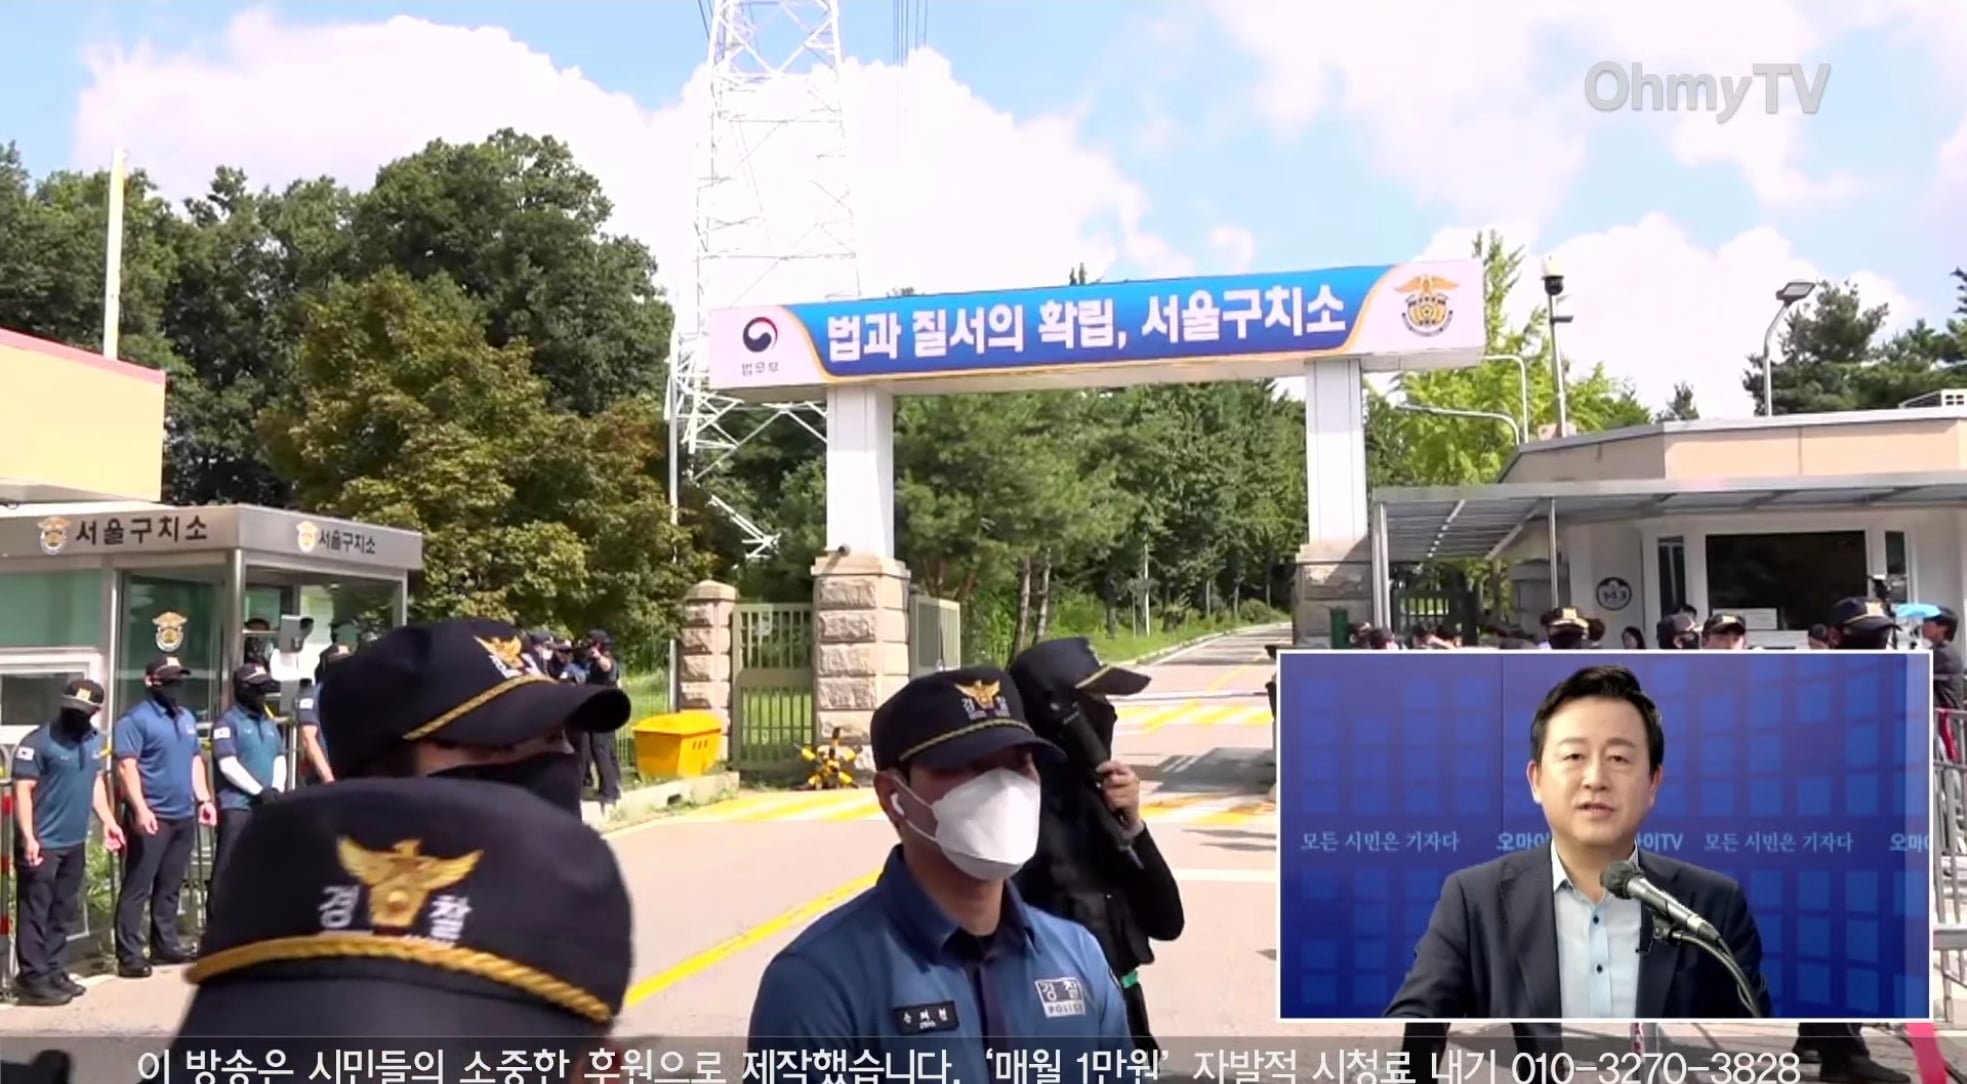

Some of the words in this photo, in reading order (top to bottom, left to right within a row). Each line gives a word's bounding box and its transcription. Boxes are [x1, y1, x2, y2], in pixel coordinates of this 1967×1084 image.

[826, 312, 901, 363] 법과
[912, 304, 1024, 358] 질서의
[1038, 299, 1127, 351] 확립,
[1141, 284, 1347, 344] 서울구치소
[75, 515, 208, 546] 서울구치소
[318, 530, 376, 555] 서울구치소
[1302, 832, 1338, 852] 모든
[1345, 831, 1400, 853] 시민은
[1405, 831, 1460, 853] 기자다
[1704, 832, 1740, 852] 모든
[1744, 831, 1797, 853] 시민은
[1803, 831, 1854, 853] 기자다
